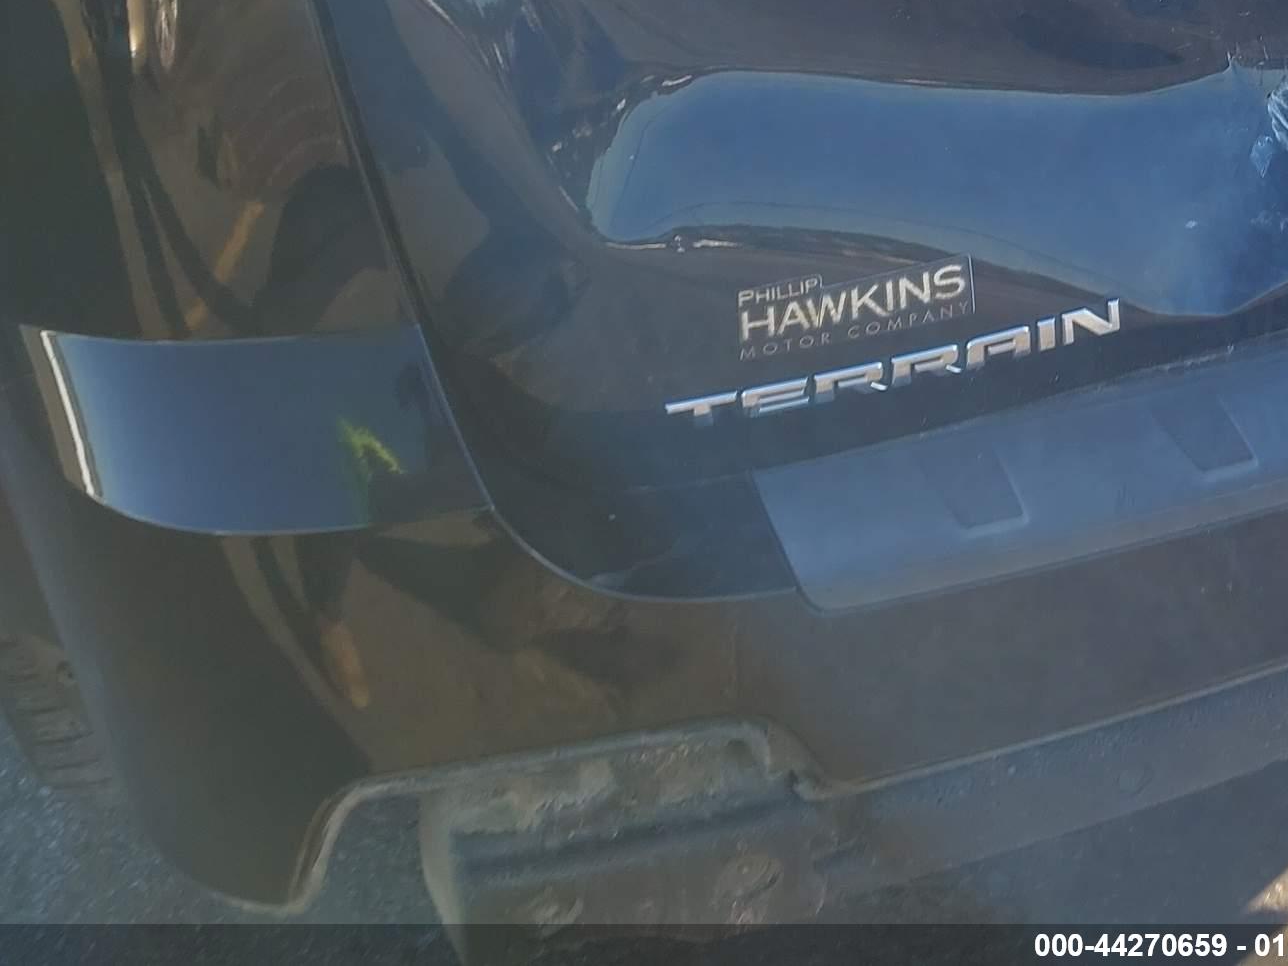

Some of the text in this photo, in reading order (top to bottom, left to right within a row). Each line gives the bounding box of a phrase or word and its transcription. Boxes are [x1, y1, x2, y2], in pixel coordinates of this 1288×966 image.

[738, 275, 818, 307] PHILLIP
[741, 264, 966, 341] HAWKINS
[665, 298, 1121, 425] TERRAIN
[739, 300, 969, 362] MOTOR COMPANY
